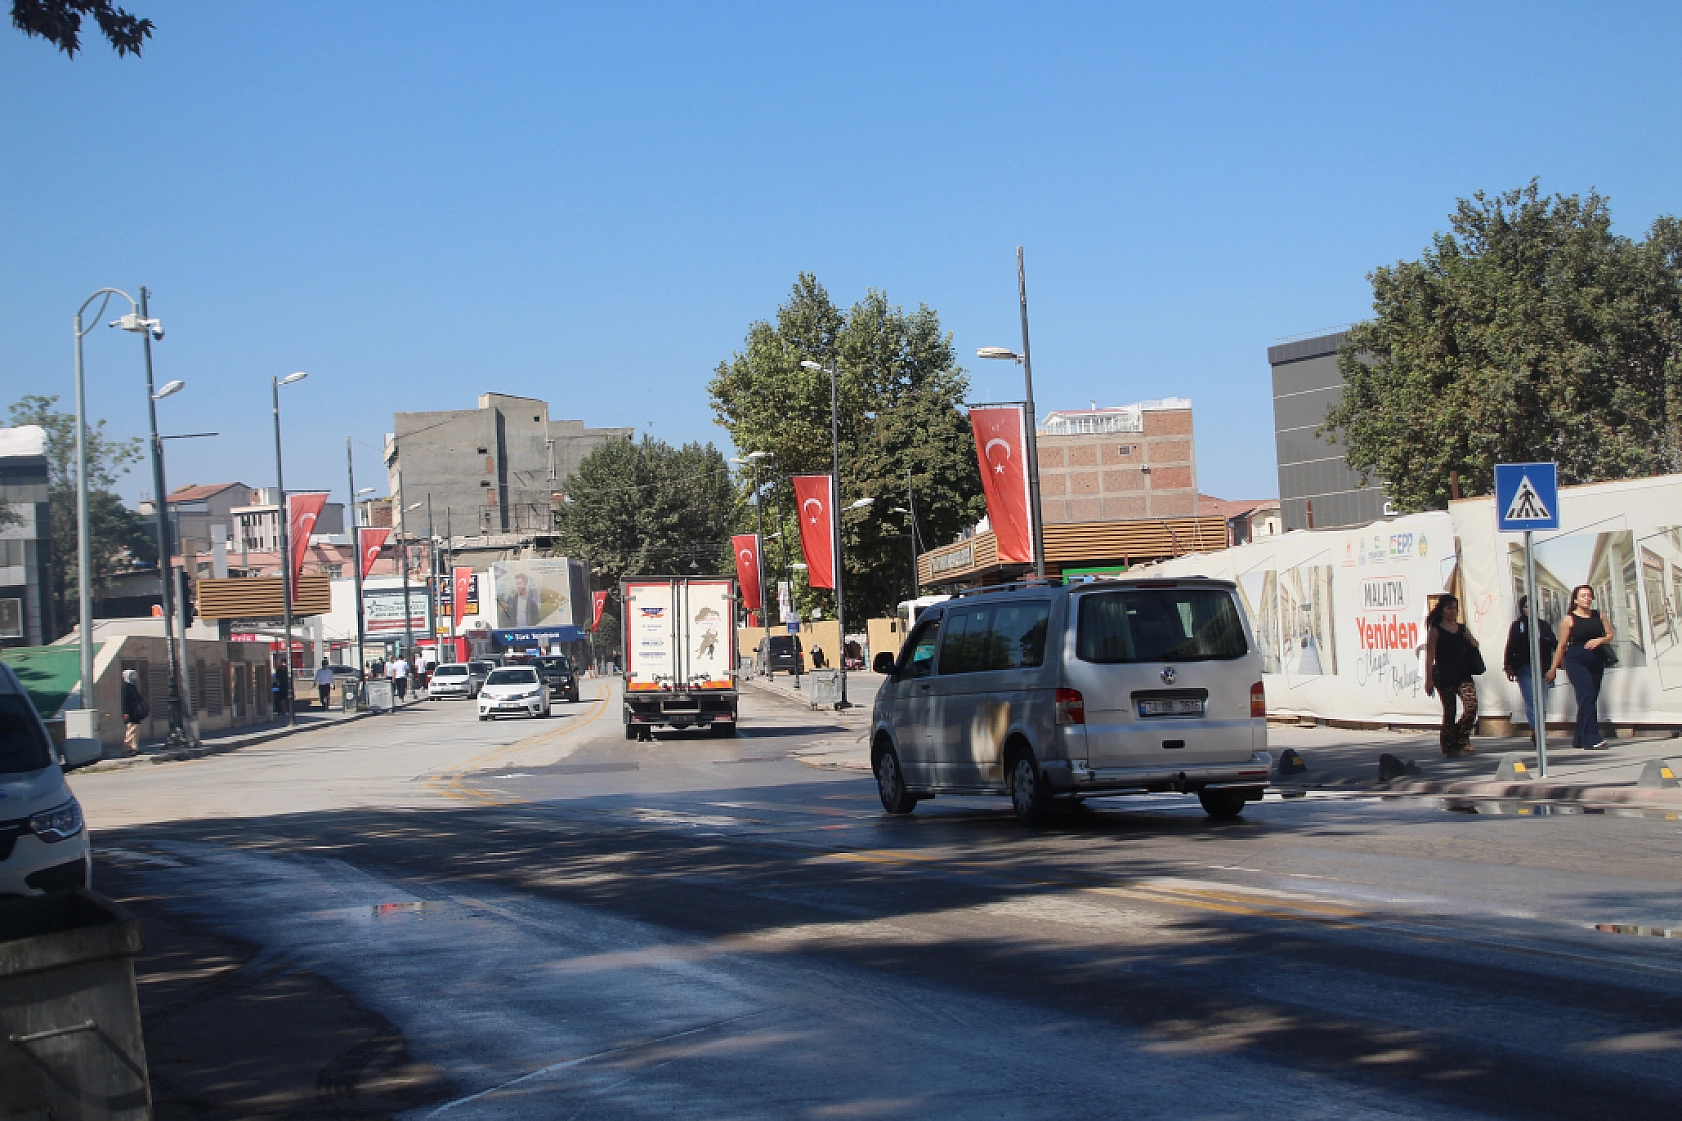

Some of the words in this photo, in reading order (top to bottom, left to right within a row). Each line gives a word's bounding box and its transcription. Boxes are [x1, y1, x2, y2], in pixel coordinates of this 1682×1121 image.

[1397, 532, 1413, 554] EPP
[1364, 581, 1405, 607] MALATYA
[1355, 614, 1418, 650] Yeniden
